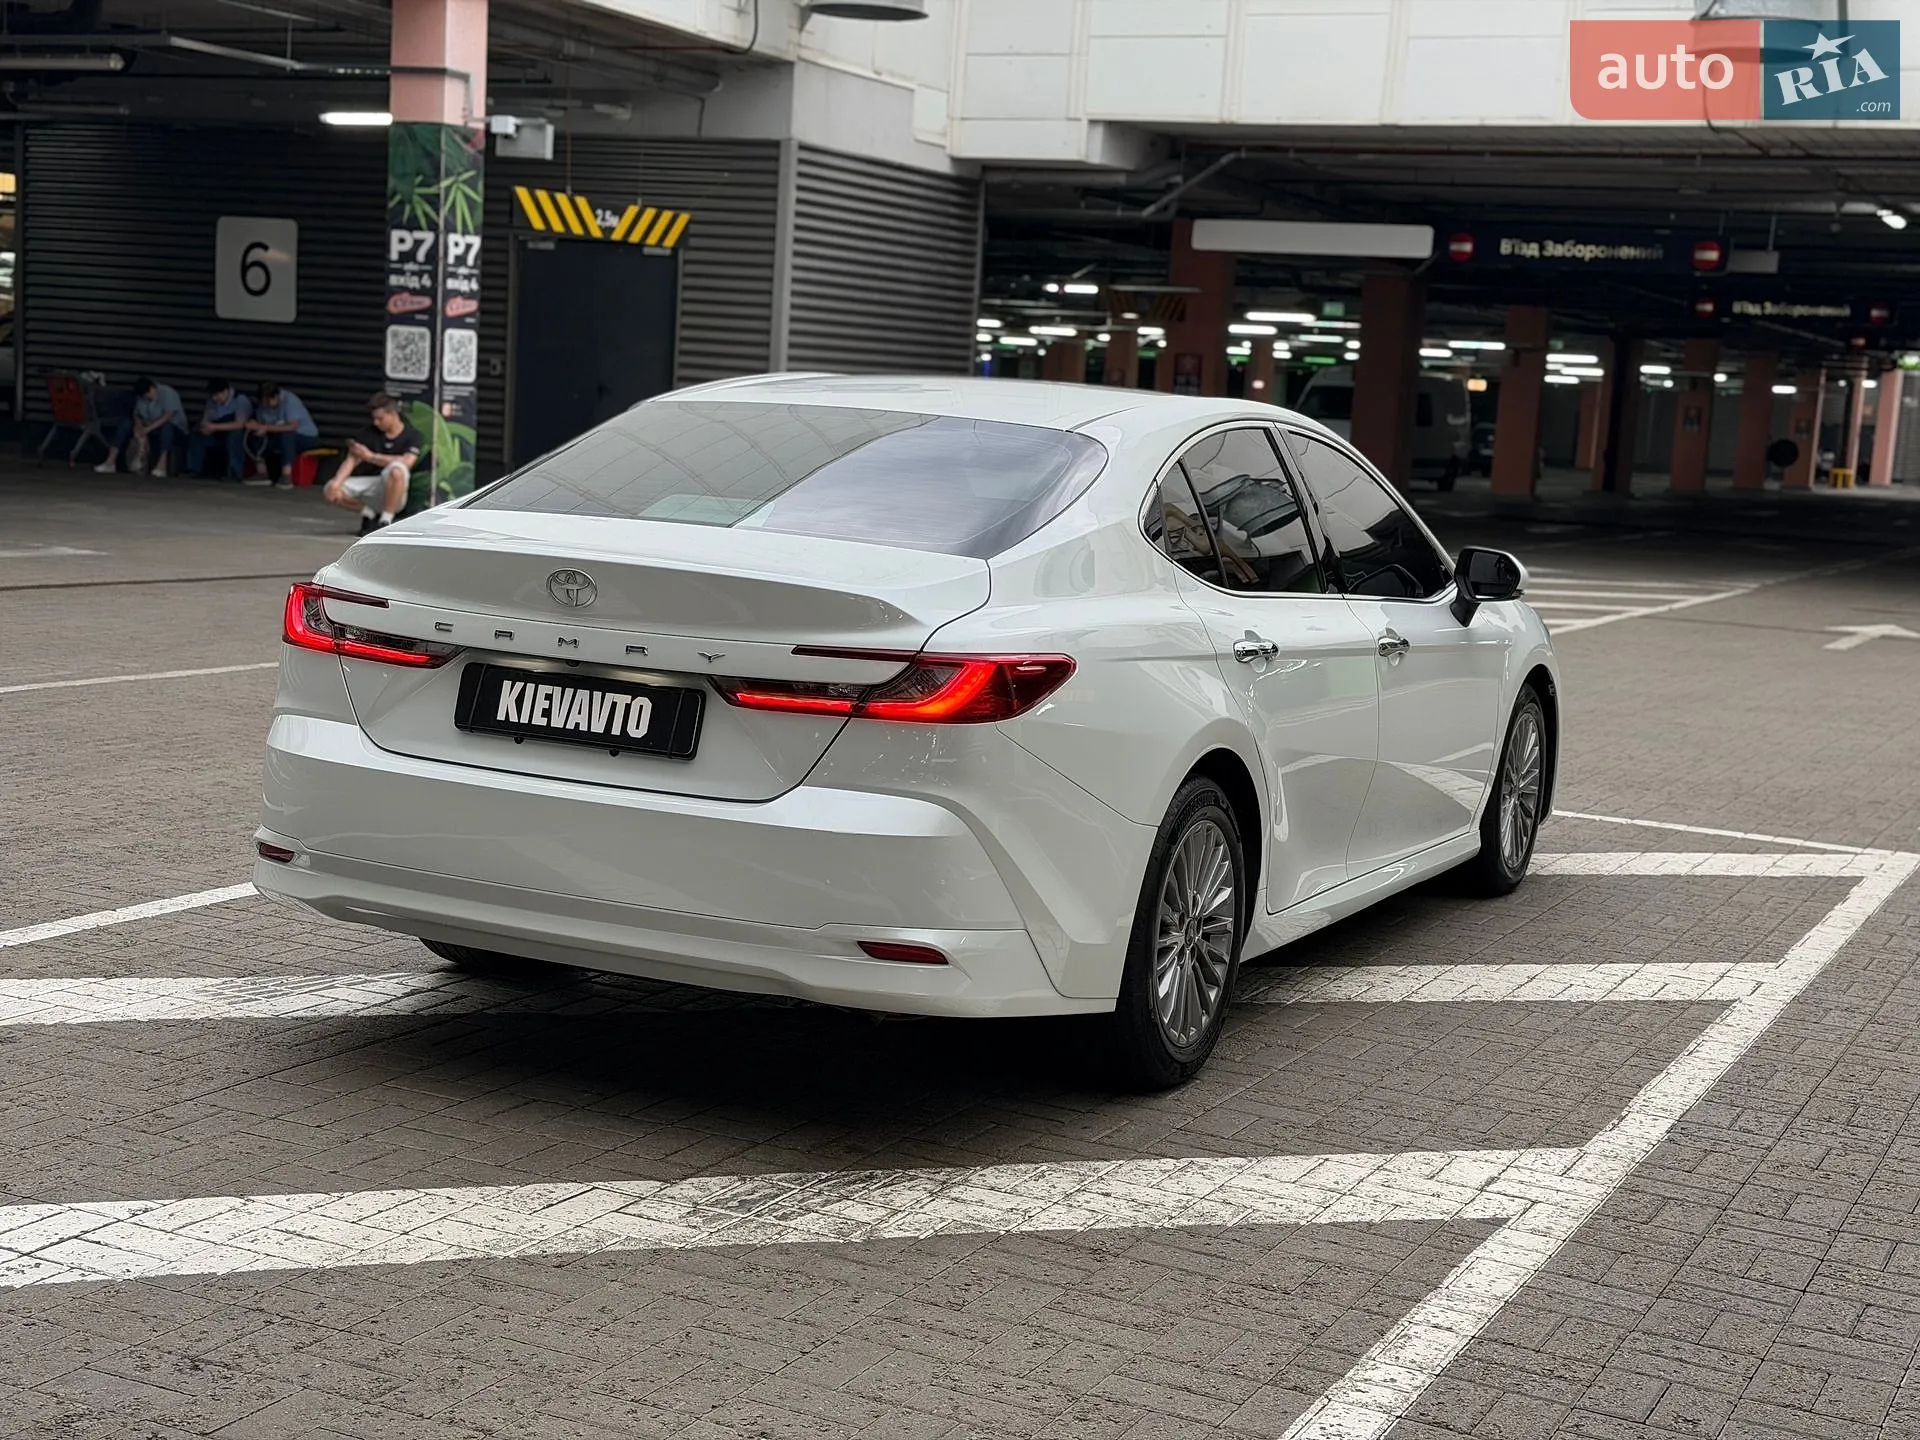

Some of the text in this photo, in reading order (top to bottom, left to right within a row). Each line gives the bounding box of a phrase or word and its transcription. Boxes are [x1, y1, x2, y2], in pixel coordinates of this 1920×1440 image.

[389, 229, 435, 263] P7
[446, 233, 482, 267] P7
[1542, 240, 1664, 262] Заборонений
[240, 241, 271, 297] 6
[434, 621, 726, 663] CAMRY
[496, 680, 652, 739] KIEVAVTO
